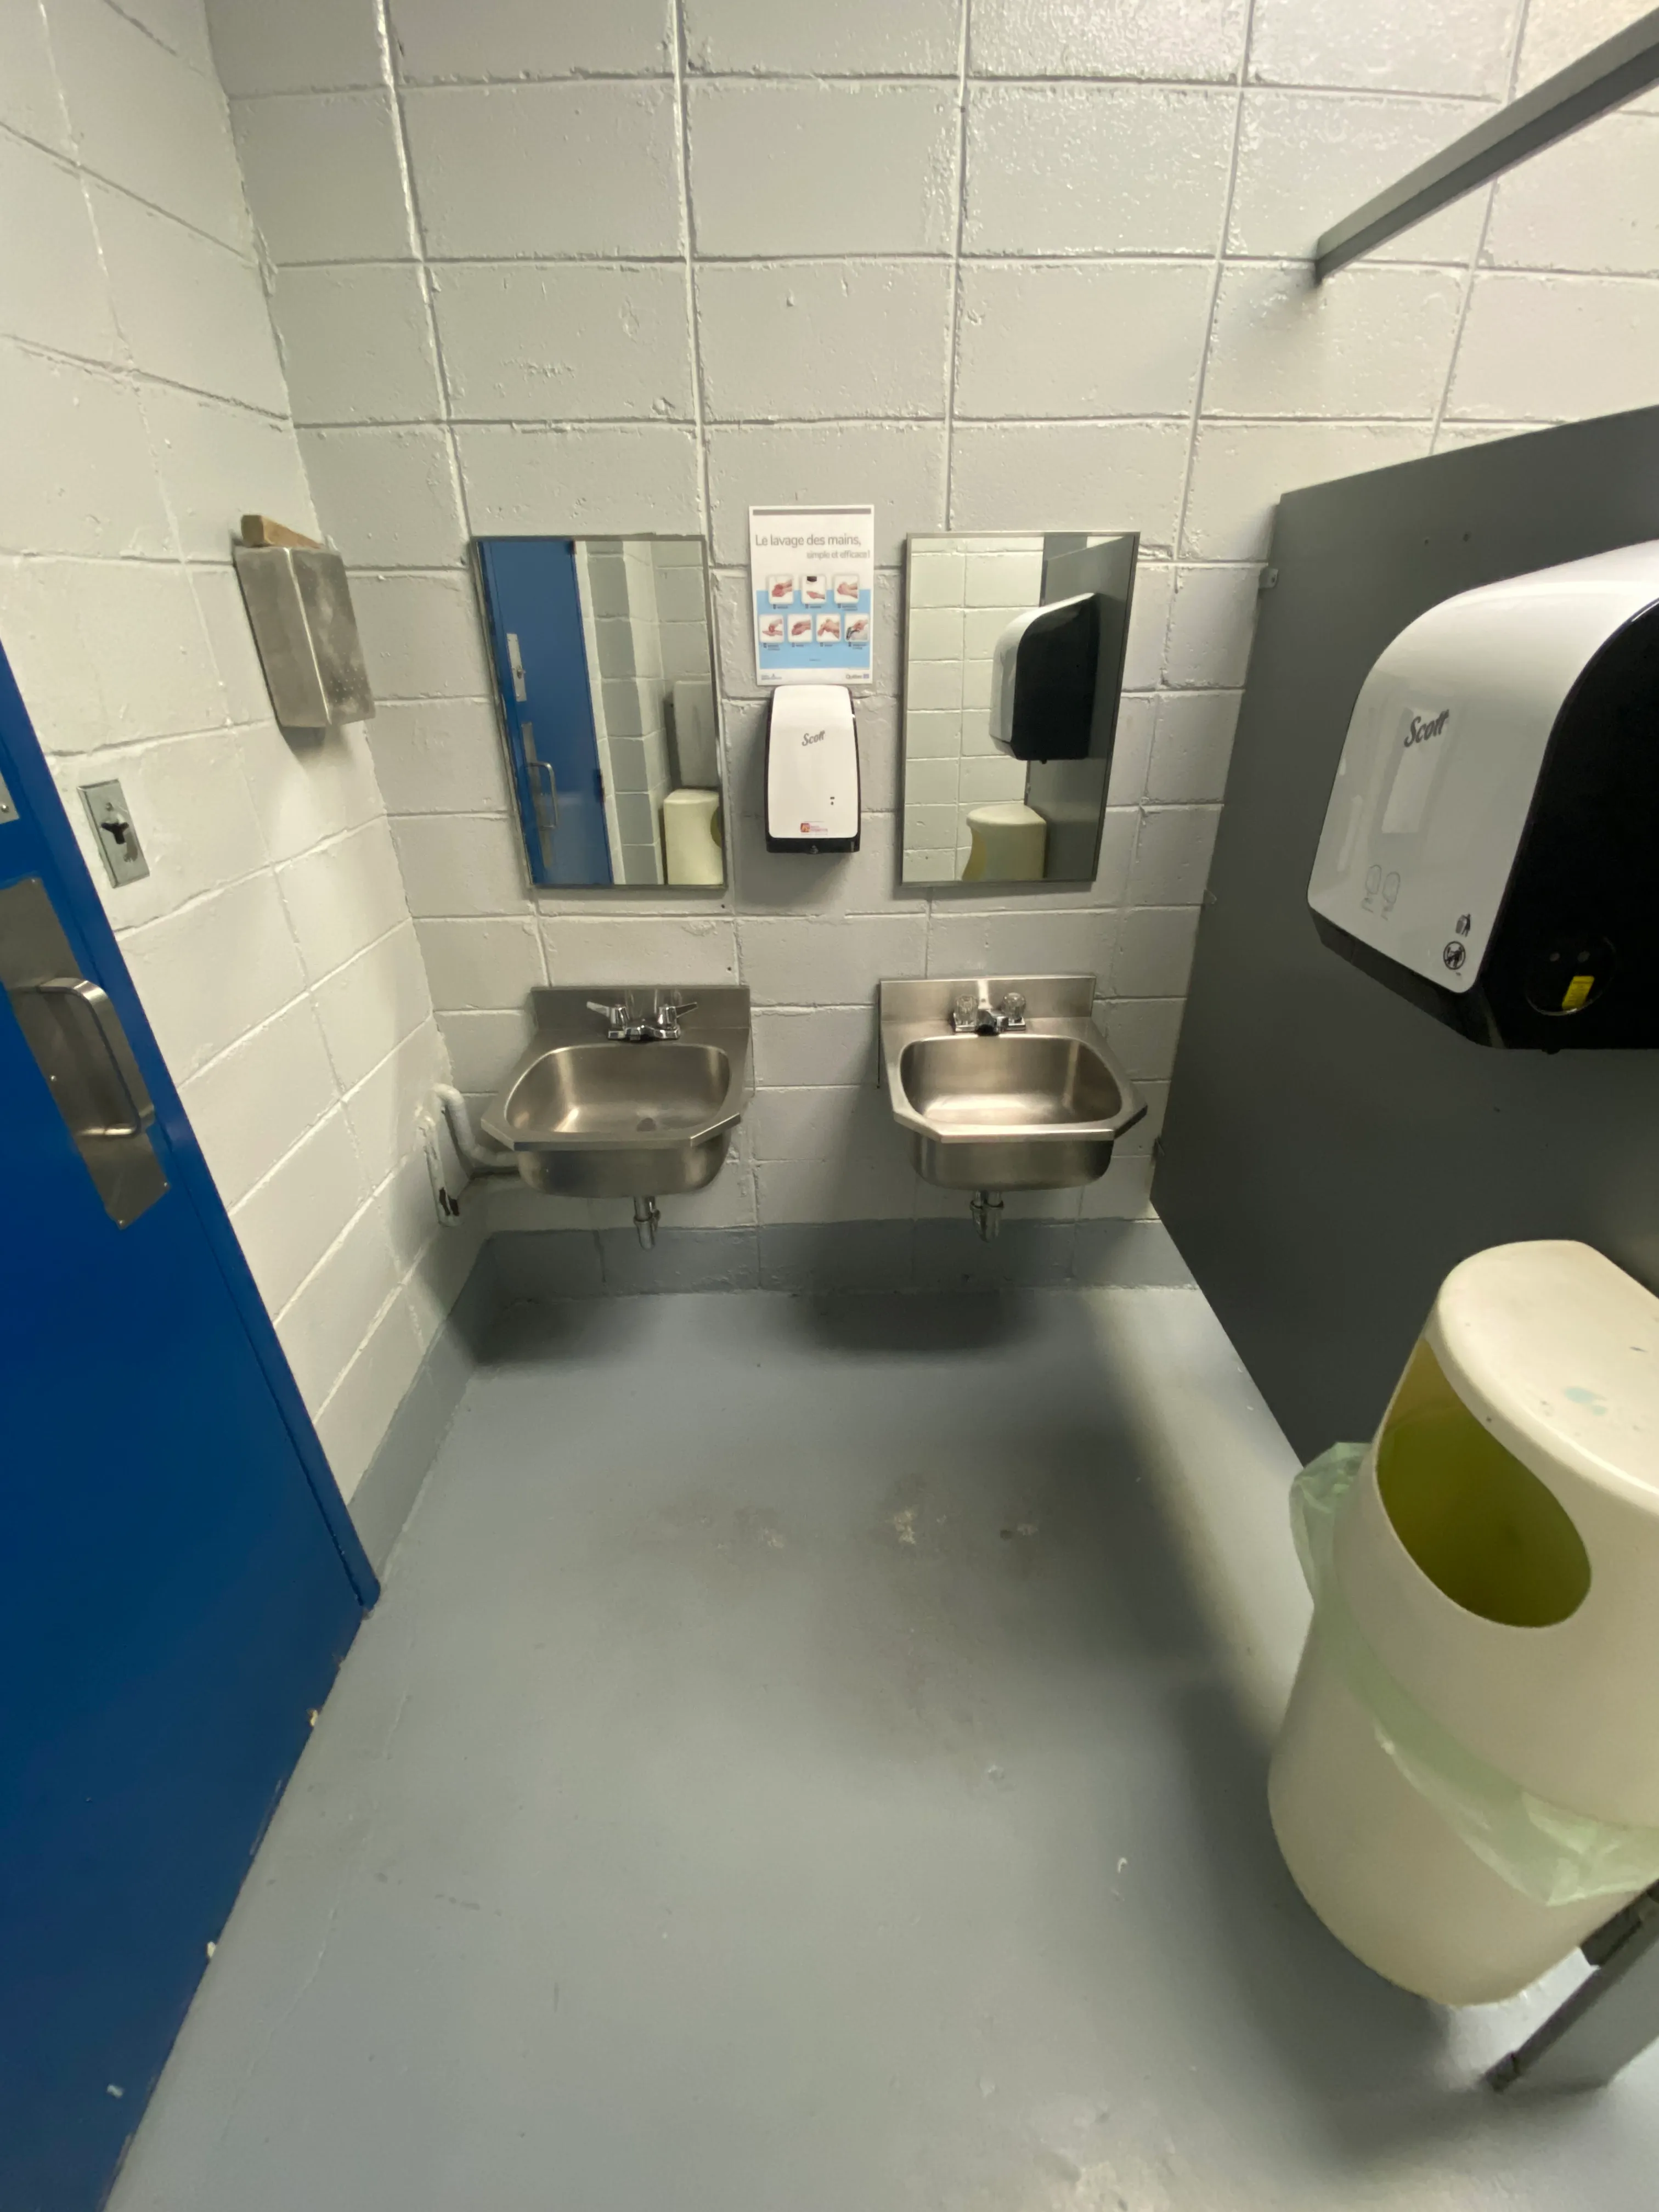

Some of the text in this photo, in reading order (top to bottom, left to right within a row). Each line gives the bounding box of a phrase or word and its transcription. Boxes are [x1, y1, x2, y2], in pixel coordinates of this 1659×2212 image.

[755, 533, 861, 548] Le lavage des mains,
[806, 550, 830, 560] simple
[1404, 709, 1449, 747] Scott
[802, 730, 825, 746] Scott
